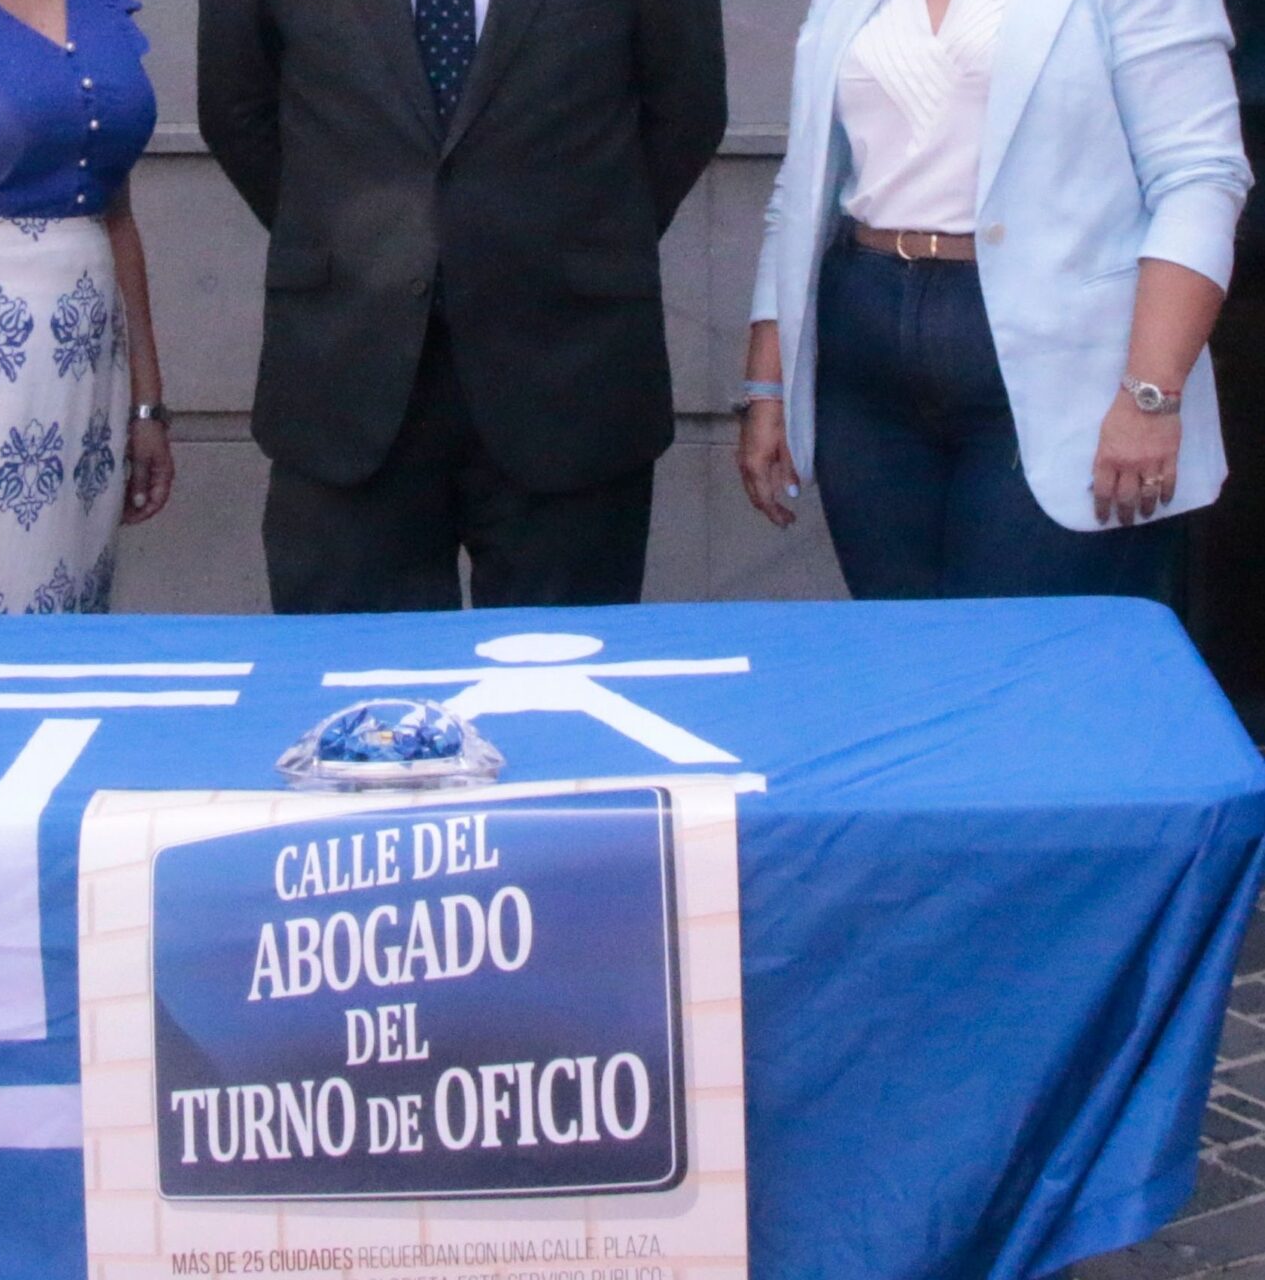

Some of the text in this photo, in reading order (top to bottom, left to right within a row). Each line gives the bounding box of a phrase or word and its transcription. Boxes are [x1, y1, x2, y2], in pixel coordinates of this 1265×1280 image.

[274, 814, 500, 901] CALLE DEL
[246, 885, 534, 1002] ABOGADO
[345, 1002, 430, 1067] DEL
[170, 1051, 651, 1165] TURNO DE OFICIO
[171, 1248, 210, 1275] MÁS
[215, 1251, 237, 1274] DE
[242, 1250, 265, 1273] 25
[269, 1247, 354, 1272] CIUDADES
[358, 1243, 459, 1269] RECUERDAN
[463, 1241, 498, 1265] CON
[502, 1239, 537, 1263] UNA
